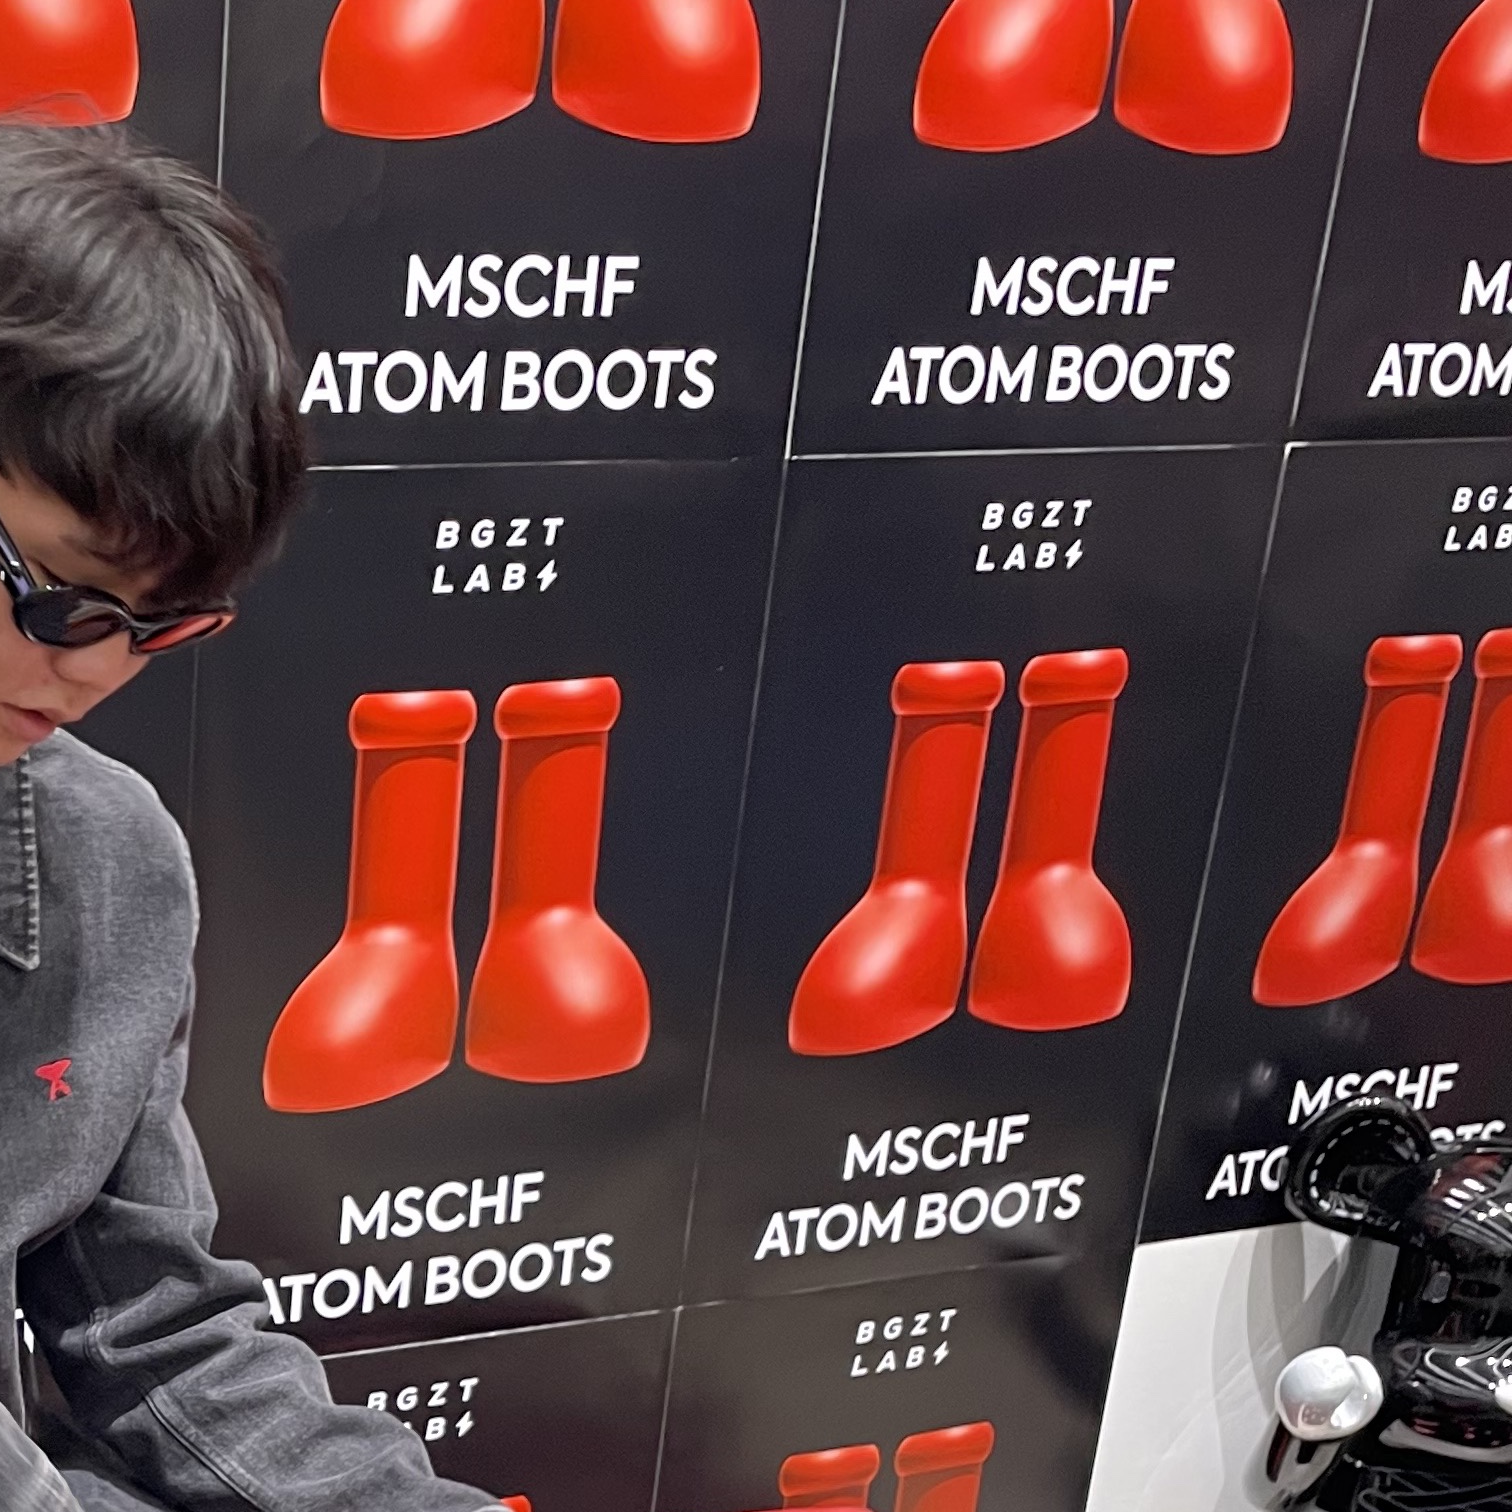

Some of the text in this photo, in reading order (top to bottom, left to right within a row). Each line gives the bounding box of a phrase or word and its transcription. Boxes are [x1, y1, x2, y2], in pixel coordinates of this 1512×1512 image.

[404, 253, 640, 319] MSCHF
[969, 255, 1176, 317] MSCHF
[298, 347, 718, 415] ATOM BOOTS
[870, 342, 1235, 406] ATOM BOOTS
[1366, 341, 1512, 398] ATOM
[435, 516, 565, 550] BGZT
[981, 499, 1093, 531] BGZT
[431, 562, 527, 595] LAB
[975, 541, 1058, 572] LAB
[842, 1113, 1030, 1182] MSCHF
[1205, 1145, 1291, 1200] ATO
[339, 1170, 545, 1245] MSCHF
[753, 1173, 1086, 1261] ATOM BOOTS
[424, 1232, 614, 1306] BOOTS
[855, 1308, 958, 1345] BGZT
[850, 1345, 926, 1378] LAB
[367, 1377, 480, 1412] BGZT
